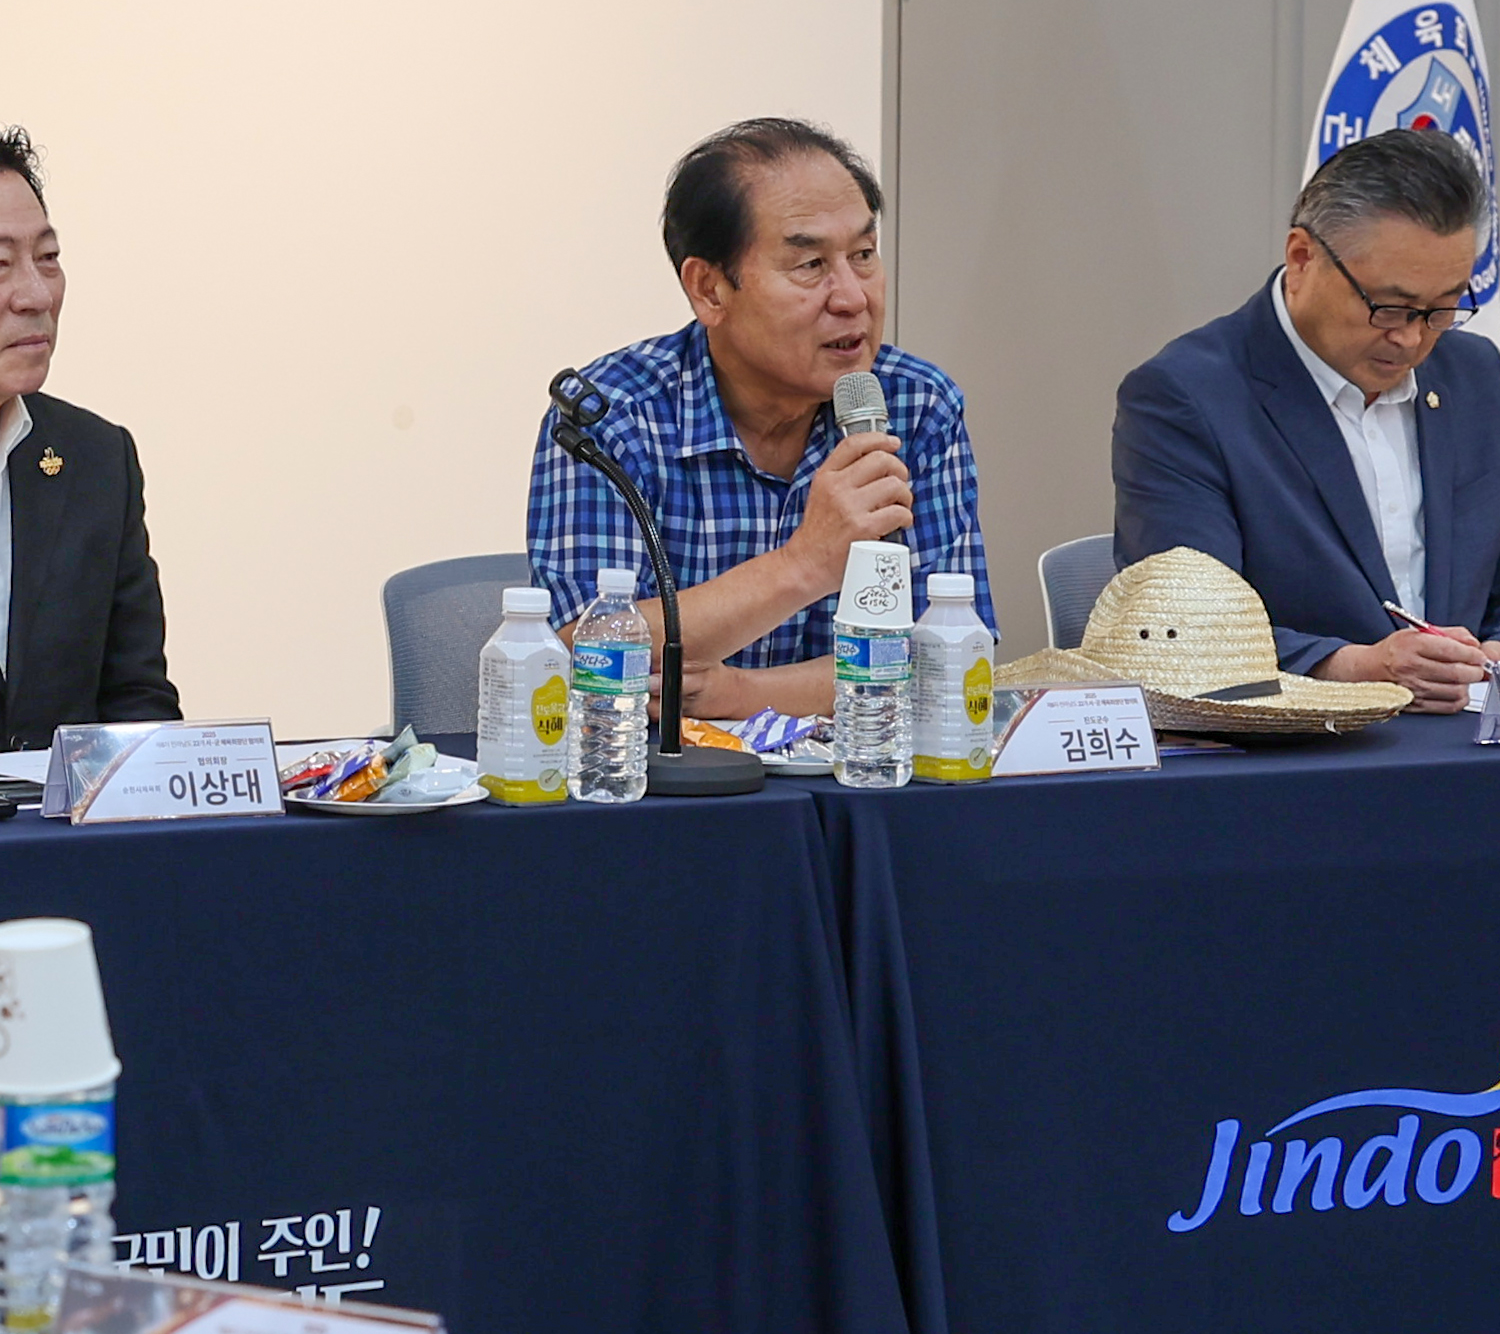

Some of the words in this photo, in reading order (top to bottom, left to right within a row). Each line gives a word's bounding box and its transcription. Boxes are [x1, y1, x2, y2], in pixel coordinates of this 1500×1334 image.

[537, 717, 563, 735] 식혜
[1060, 727, 1141, 763] 김희수
[168, 768, 263, 807] 이상대
[1167, 1114, 1483, 1233] Jindo
[258, 1206, 381, 1277] 주인!
